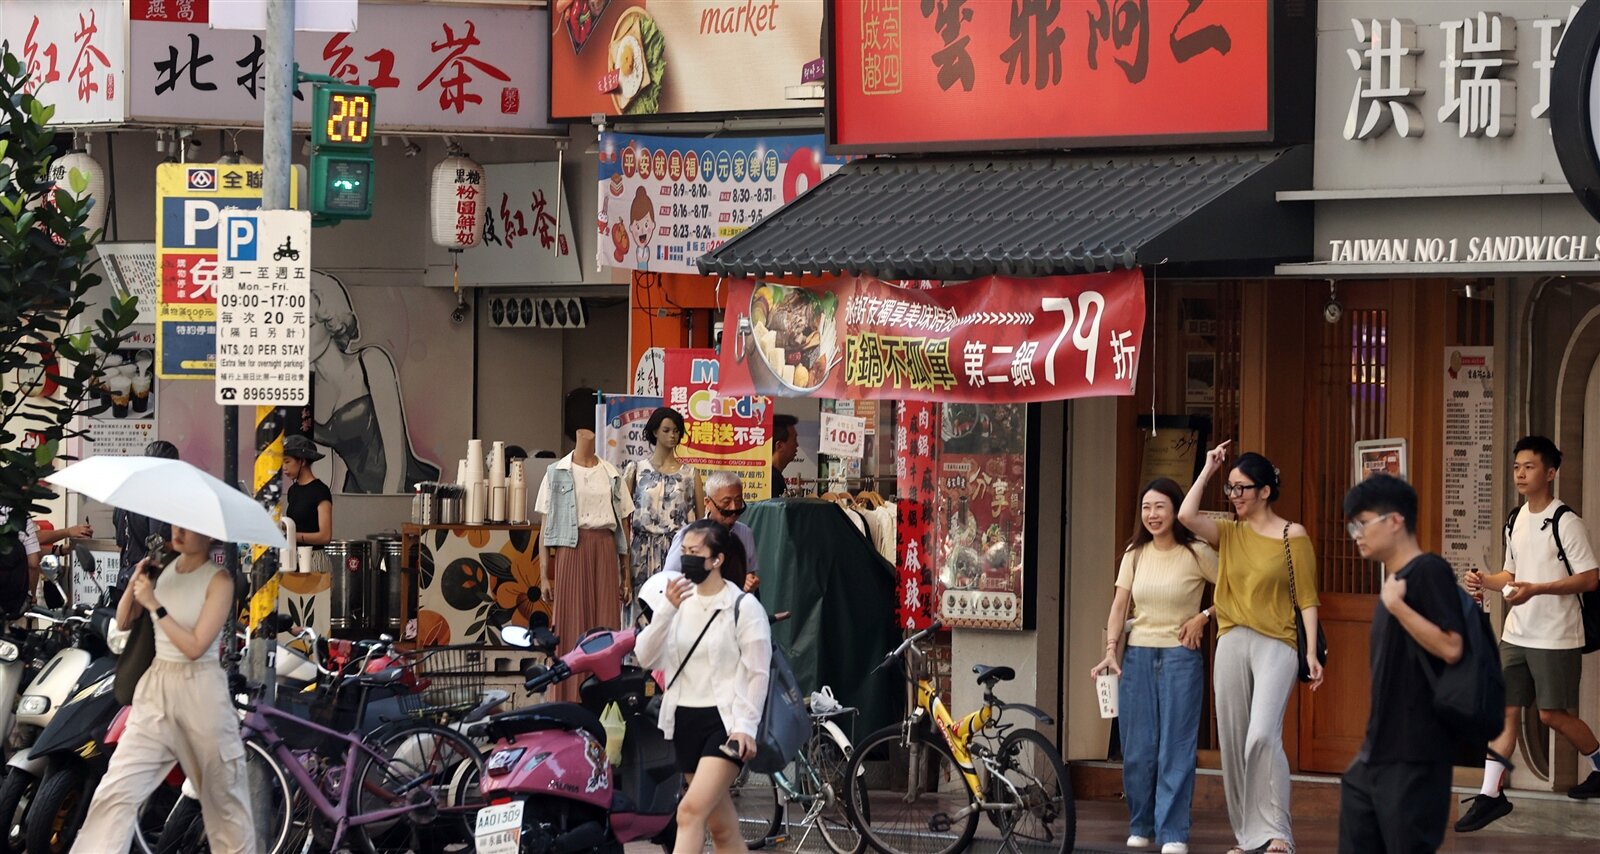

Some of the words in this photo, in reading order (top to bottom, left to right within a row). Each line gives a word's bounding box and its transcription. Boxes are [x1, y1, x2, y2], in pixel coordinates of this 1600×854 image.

[699, 0, 778, 36] market
[327, 95, 369, 142] 20
[455, 169, 480, 184] 黑糖
[184, 200, 219, 246] P
[456, 185, 478, 246] 粉圓鮮奶
[230, 220, 254, 259] P
[1329, 238, 1409, 262] TAIWAN
[1414, 237, 1459, 262] NO.1
[1467, 235, 1589, 261] SANDWICH
[222, 266, 305, 280] 週一至週五
[221, 294, 305, 308] 09:00-17:00
[243, 344, 254, 355] 20
[258, 344, 277, 355] PER
[281, 344, 305, 356] STAY
[243, 387, 305, 401] 89659555
[830, 429, 857, 445] 100
[918, 400, 929, 457] 肉鍋
